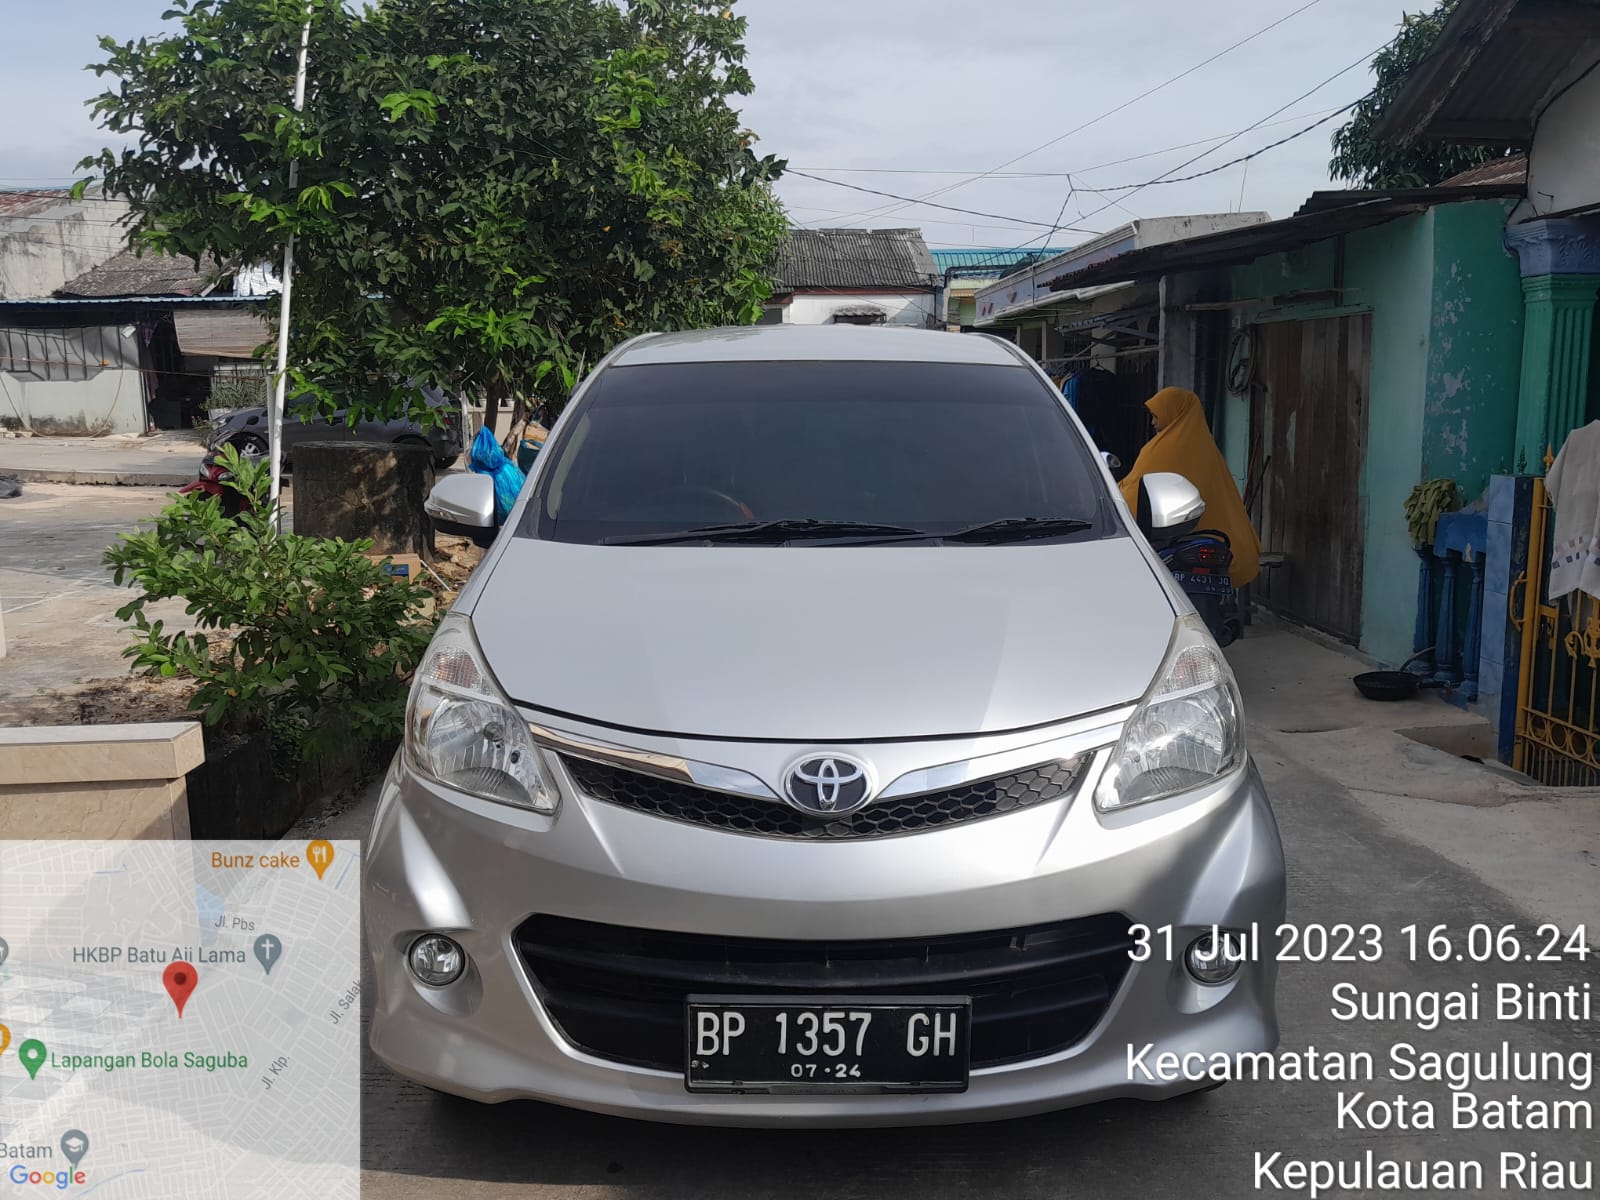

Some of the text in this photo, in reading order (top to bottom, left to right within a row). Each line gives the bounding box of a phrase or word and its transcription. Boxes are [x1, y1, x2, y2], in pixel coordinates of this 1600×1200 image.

[696, 1012, 956, 1057] BP 1357 GH
